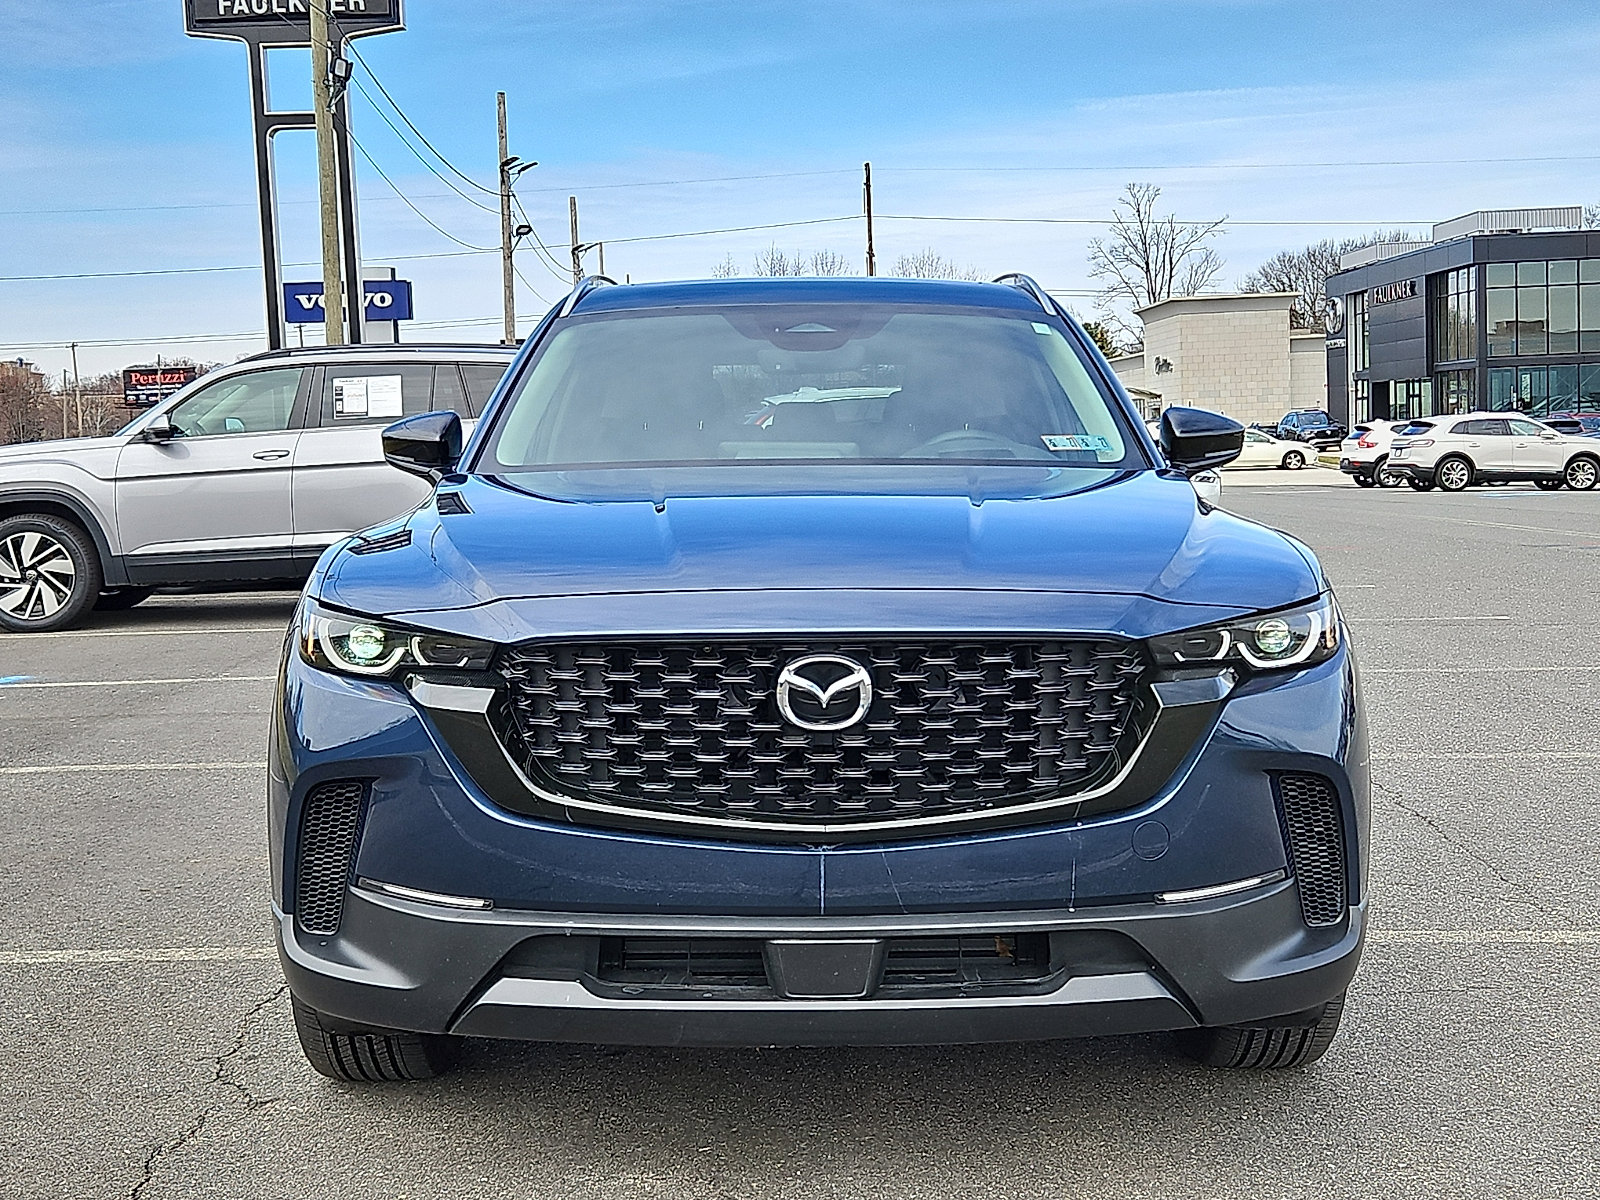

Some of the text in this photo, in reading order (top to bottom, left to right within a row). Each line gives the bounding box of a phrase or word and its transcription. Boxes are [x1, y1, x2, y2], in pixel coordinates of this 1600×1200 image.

[218, 0, 366, 15] FAULKER
[1373, 280, 1412, 304] FAULKNER
[130, 370, 186, 385] Peruzzi
